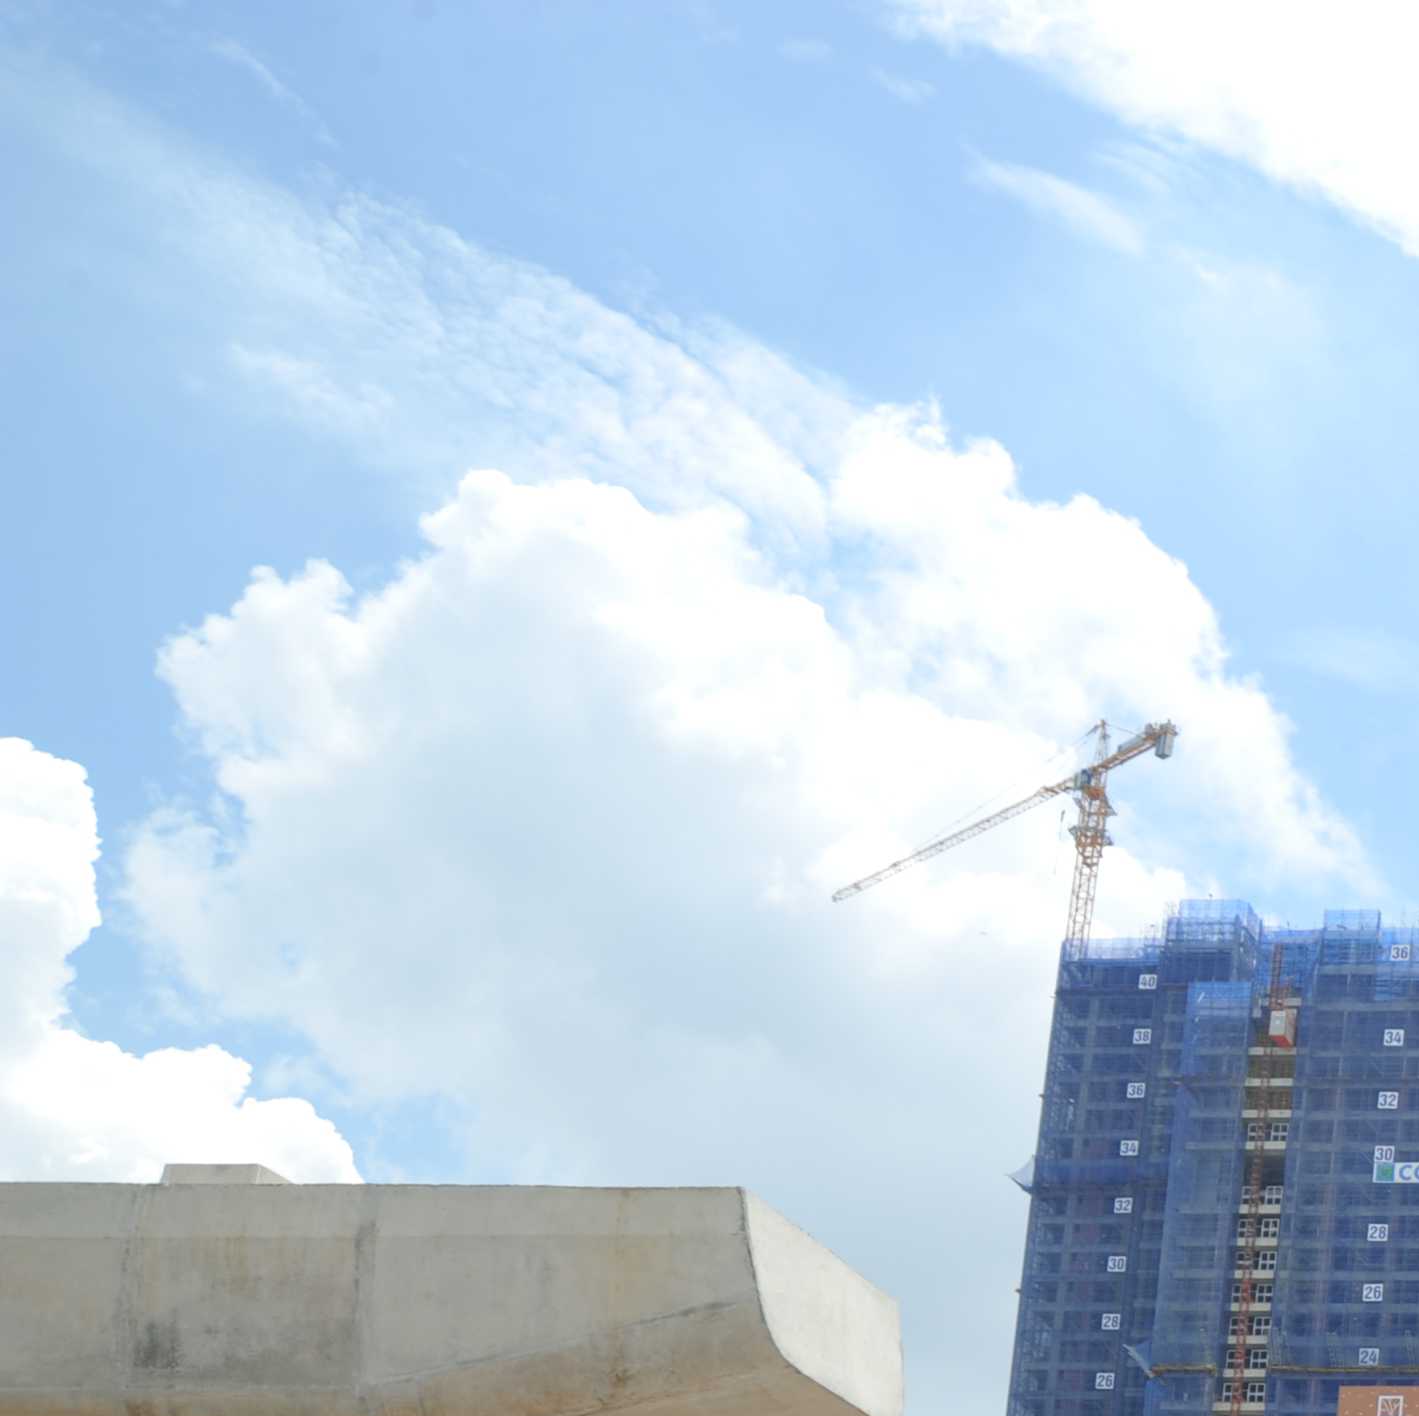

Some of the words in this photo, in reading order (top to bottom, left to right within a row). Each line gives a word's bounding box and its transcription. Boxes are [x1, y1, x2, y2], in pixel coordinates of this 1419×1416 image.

[1392, 946, 1408, 960] 36
[1135, 1029, 1150, 1042] 38
[1386, 1031, 1402, 1044] 34
[1128, 1084, 1143, 1096] 36
[1380, 1094, 1396, 1107] 32
[1122, 1141, 1136, 1154] 34
[1376, 1148, 1392, 1161] 30
[1114, 1200, 1130, 1211] 32
[1370, 1226, 1386, 1240] 28
[1108, 1258, 1124, 1270] 30
[1364, 1286, 1381, 1300] 26
[1103, 1316, 1118, 1328] 28
[1360, 1350, 1377, 1364] 24
[1098, 1374, 1112, 1387] 26
